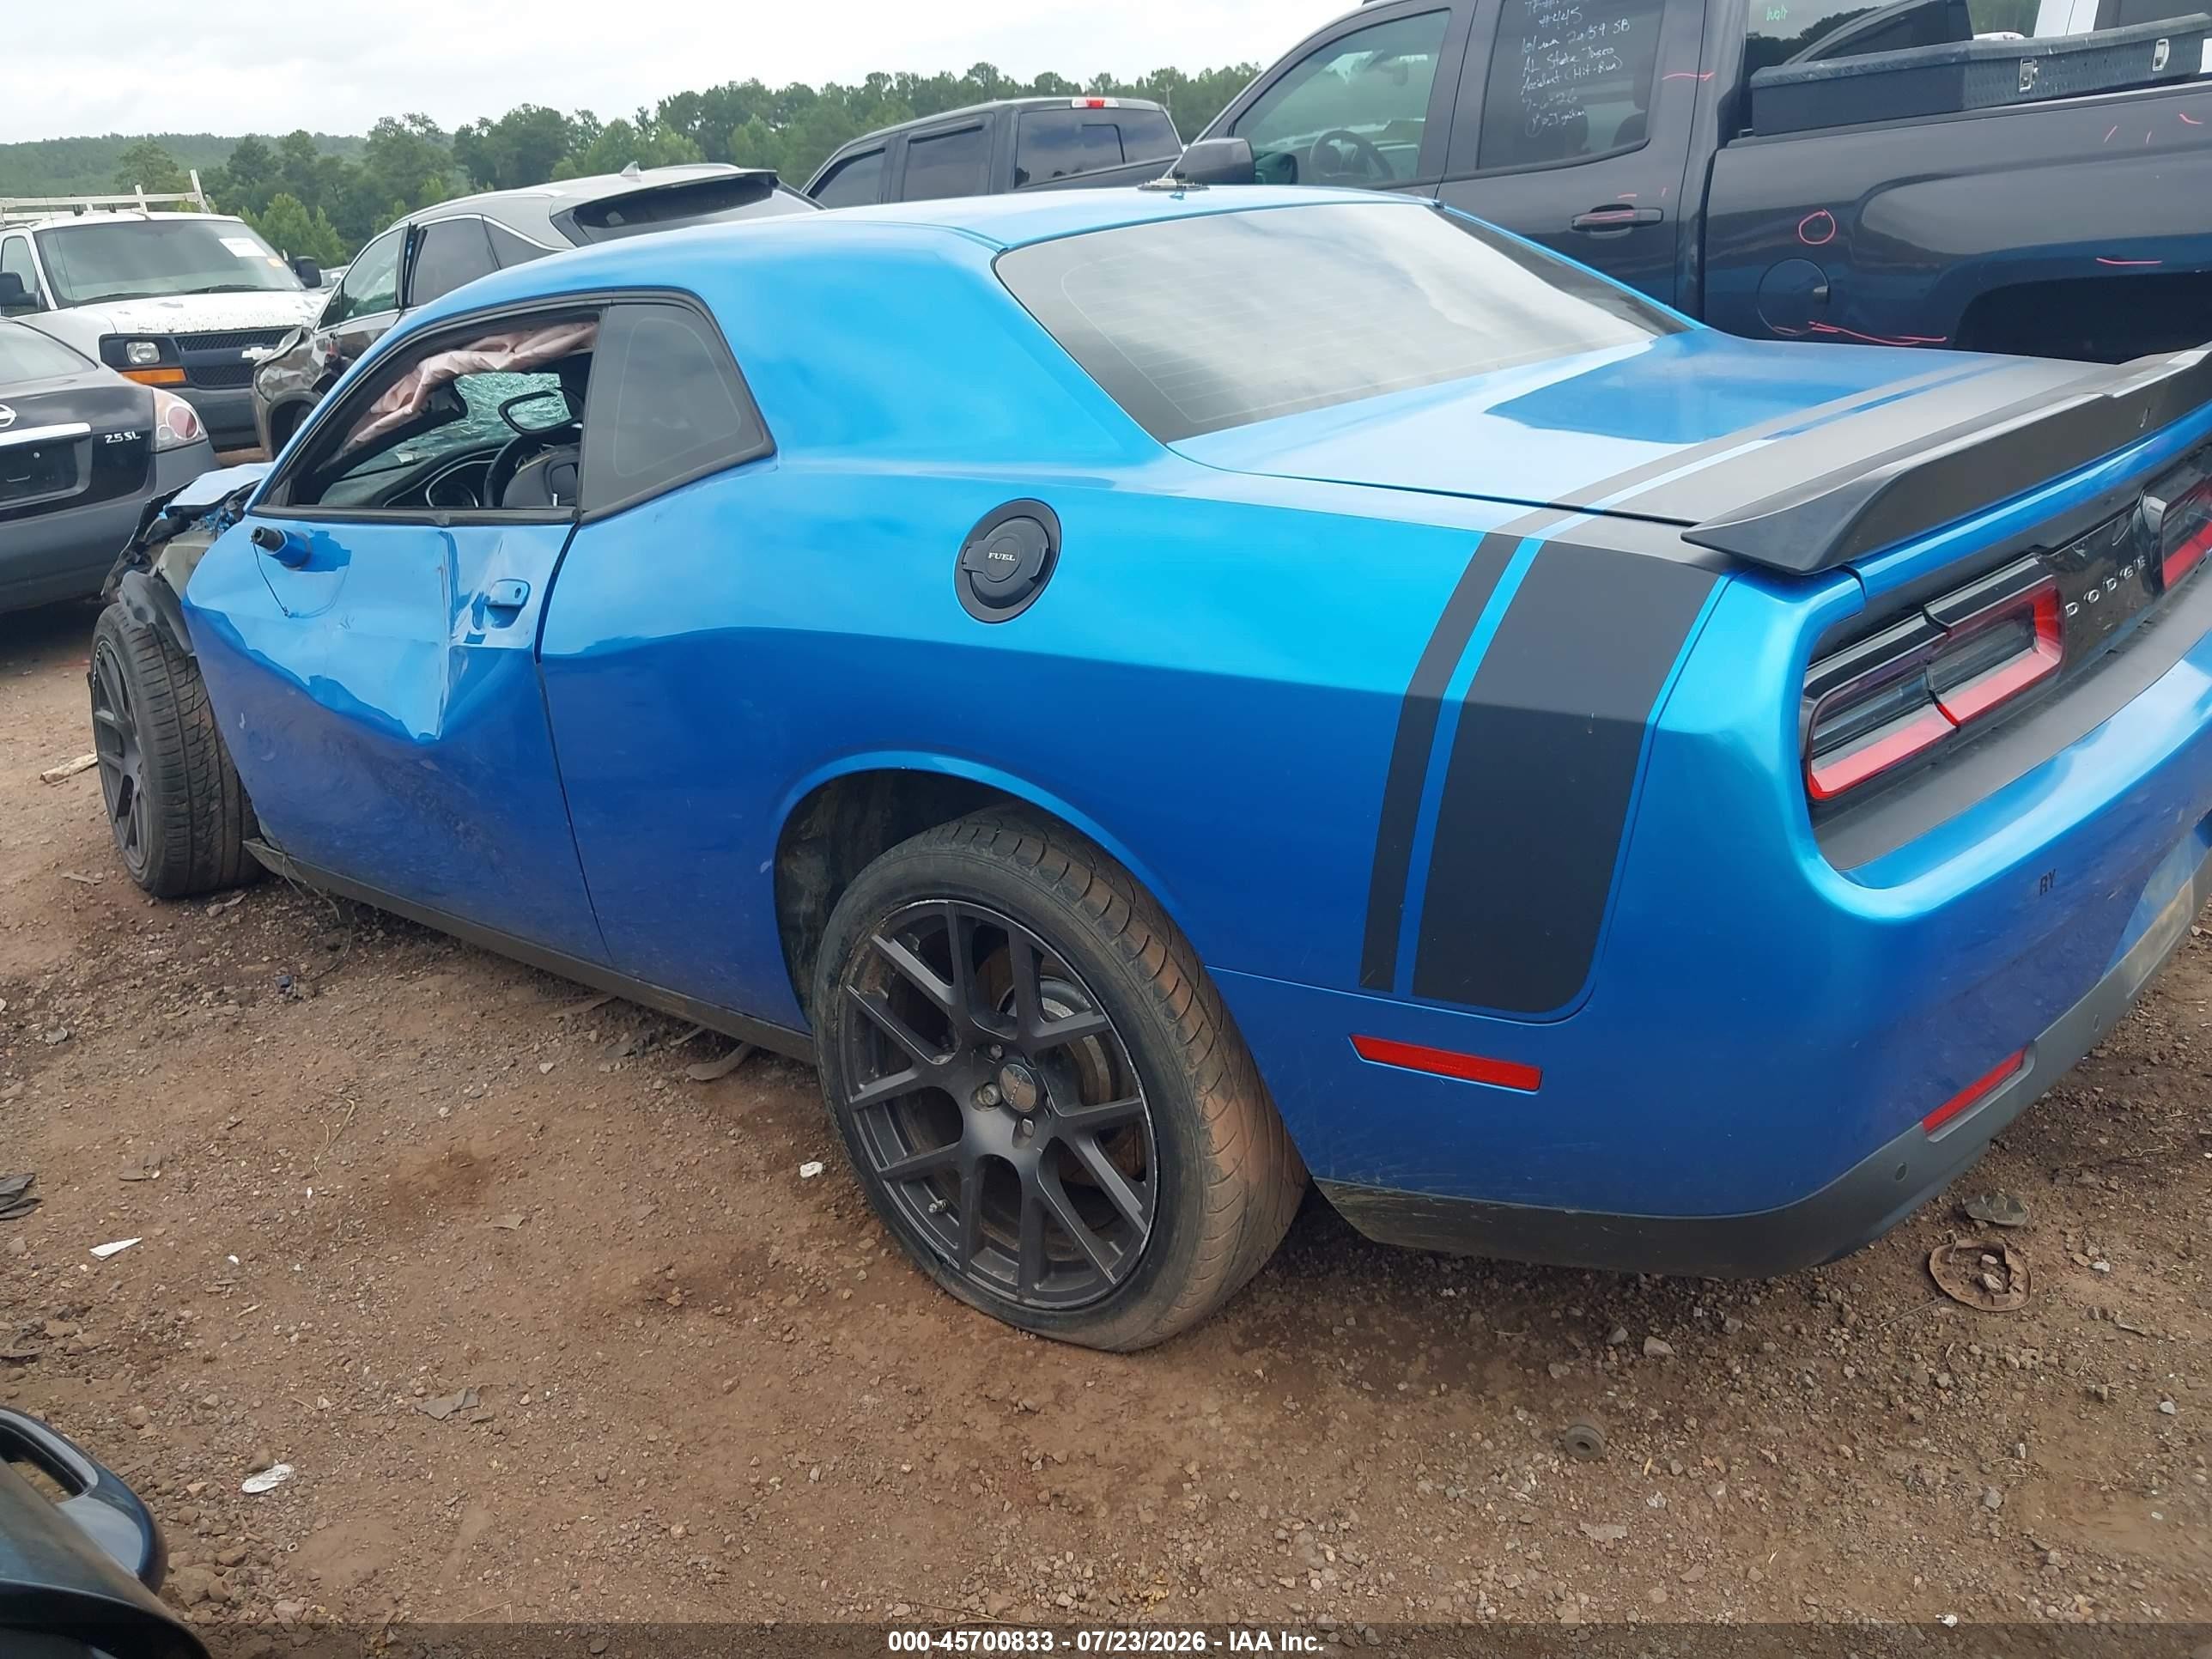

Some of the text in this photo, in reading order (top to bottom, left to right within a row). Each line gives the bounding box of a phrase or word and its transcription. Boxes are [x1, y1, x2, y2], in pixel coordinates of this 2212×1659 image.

[1613, 18, 1630, 33] SB
[124, 430, 142, 441] SL
[988, 552, 1016, 562] FUEL
[2065, 555, 2146, 618] DODGE
